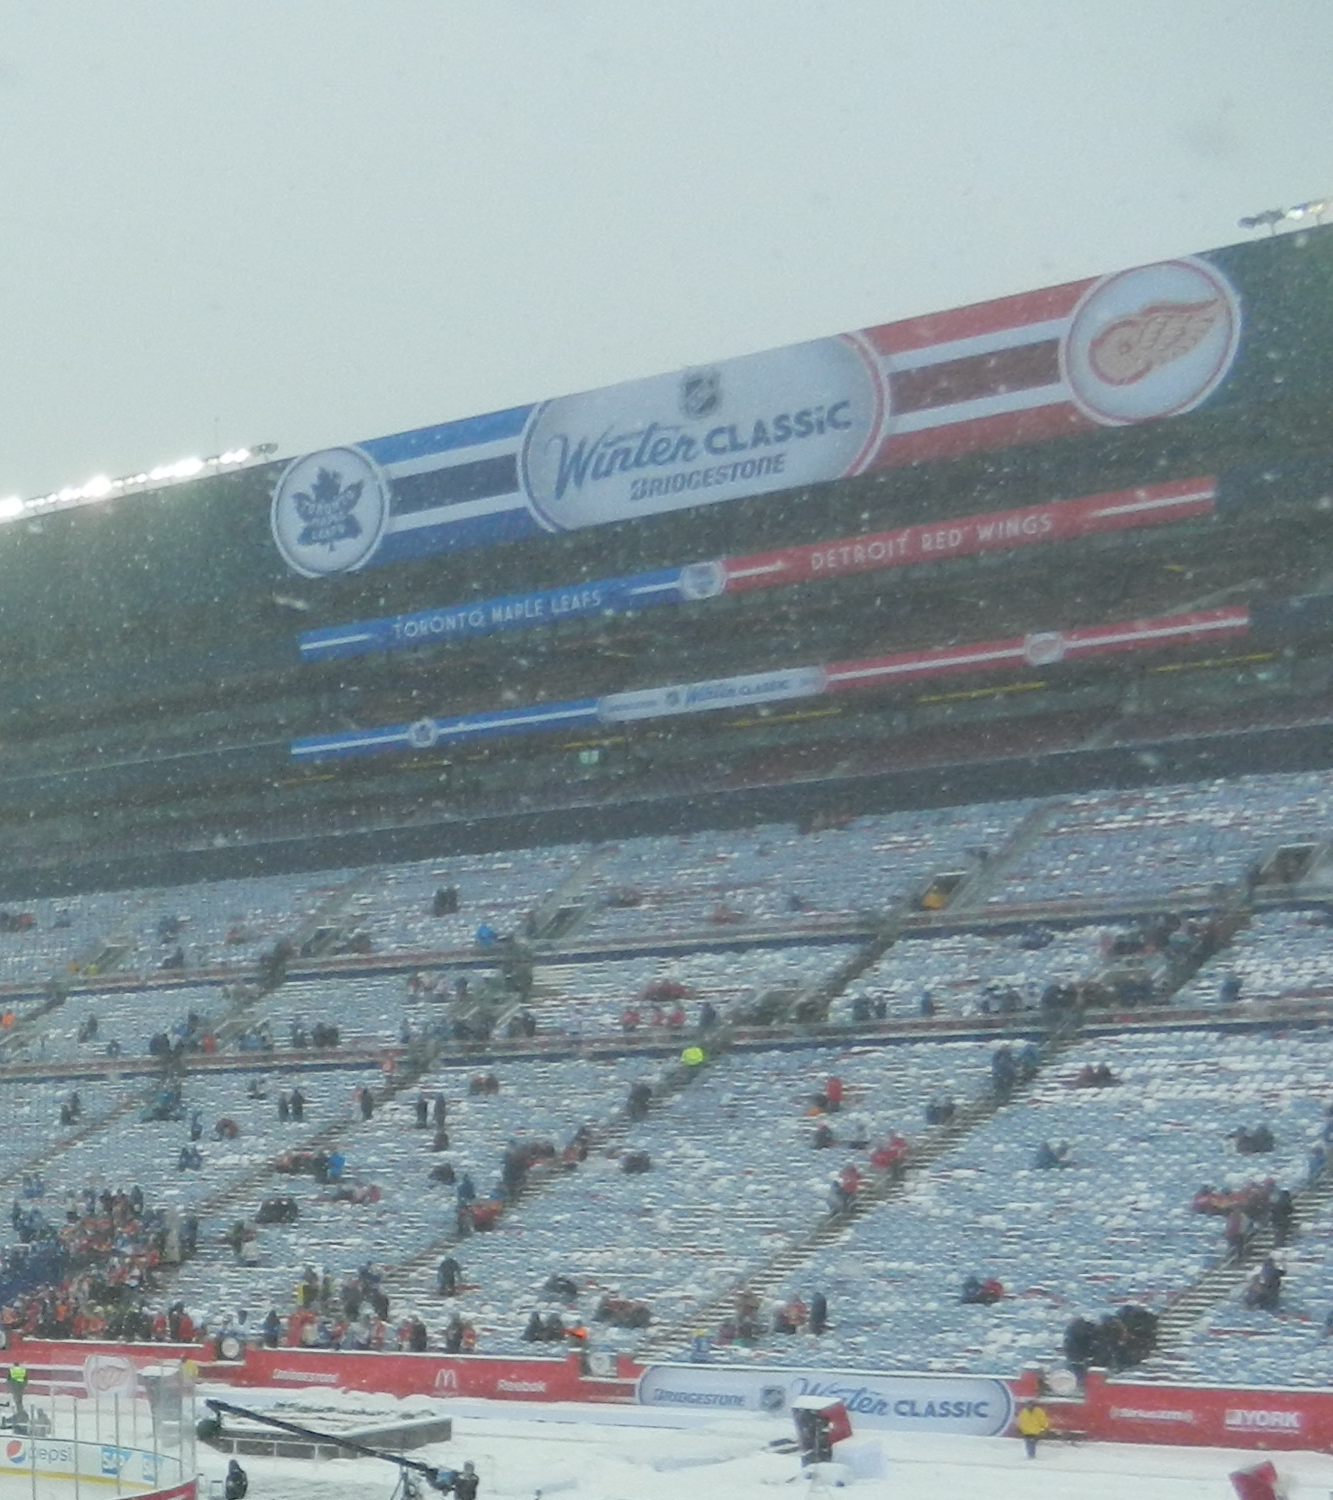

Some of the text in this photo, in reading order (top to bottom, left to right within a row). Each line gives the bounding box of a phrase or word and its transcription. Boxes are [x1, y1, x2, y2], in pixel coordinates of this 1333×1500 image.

[544, 400, 852, 501] Winter CLASSIC
[631, 454, 786, 500] BRIDGESTONE
[811, 514, 1053, 571] DETROIT RED WINGS
[392, 590, 604, 640] TORONTO MAPLE LEAFS
[653, 1387, 745, 1407] BRIDGESTONE
[894, 1401, 989, 1418] CLASSIC
[1244, 1411, 1300, 1427] YORK
